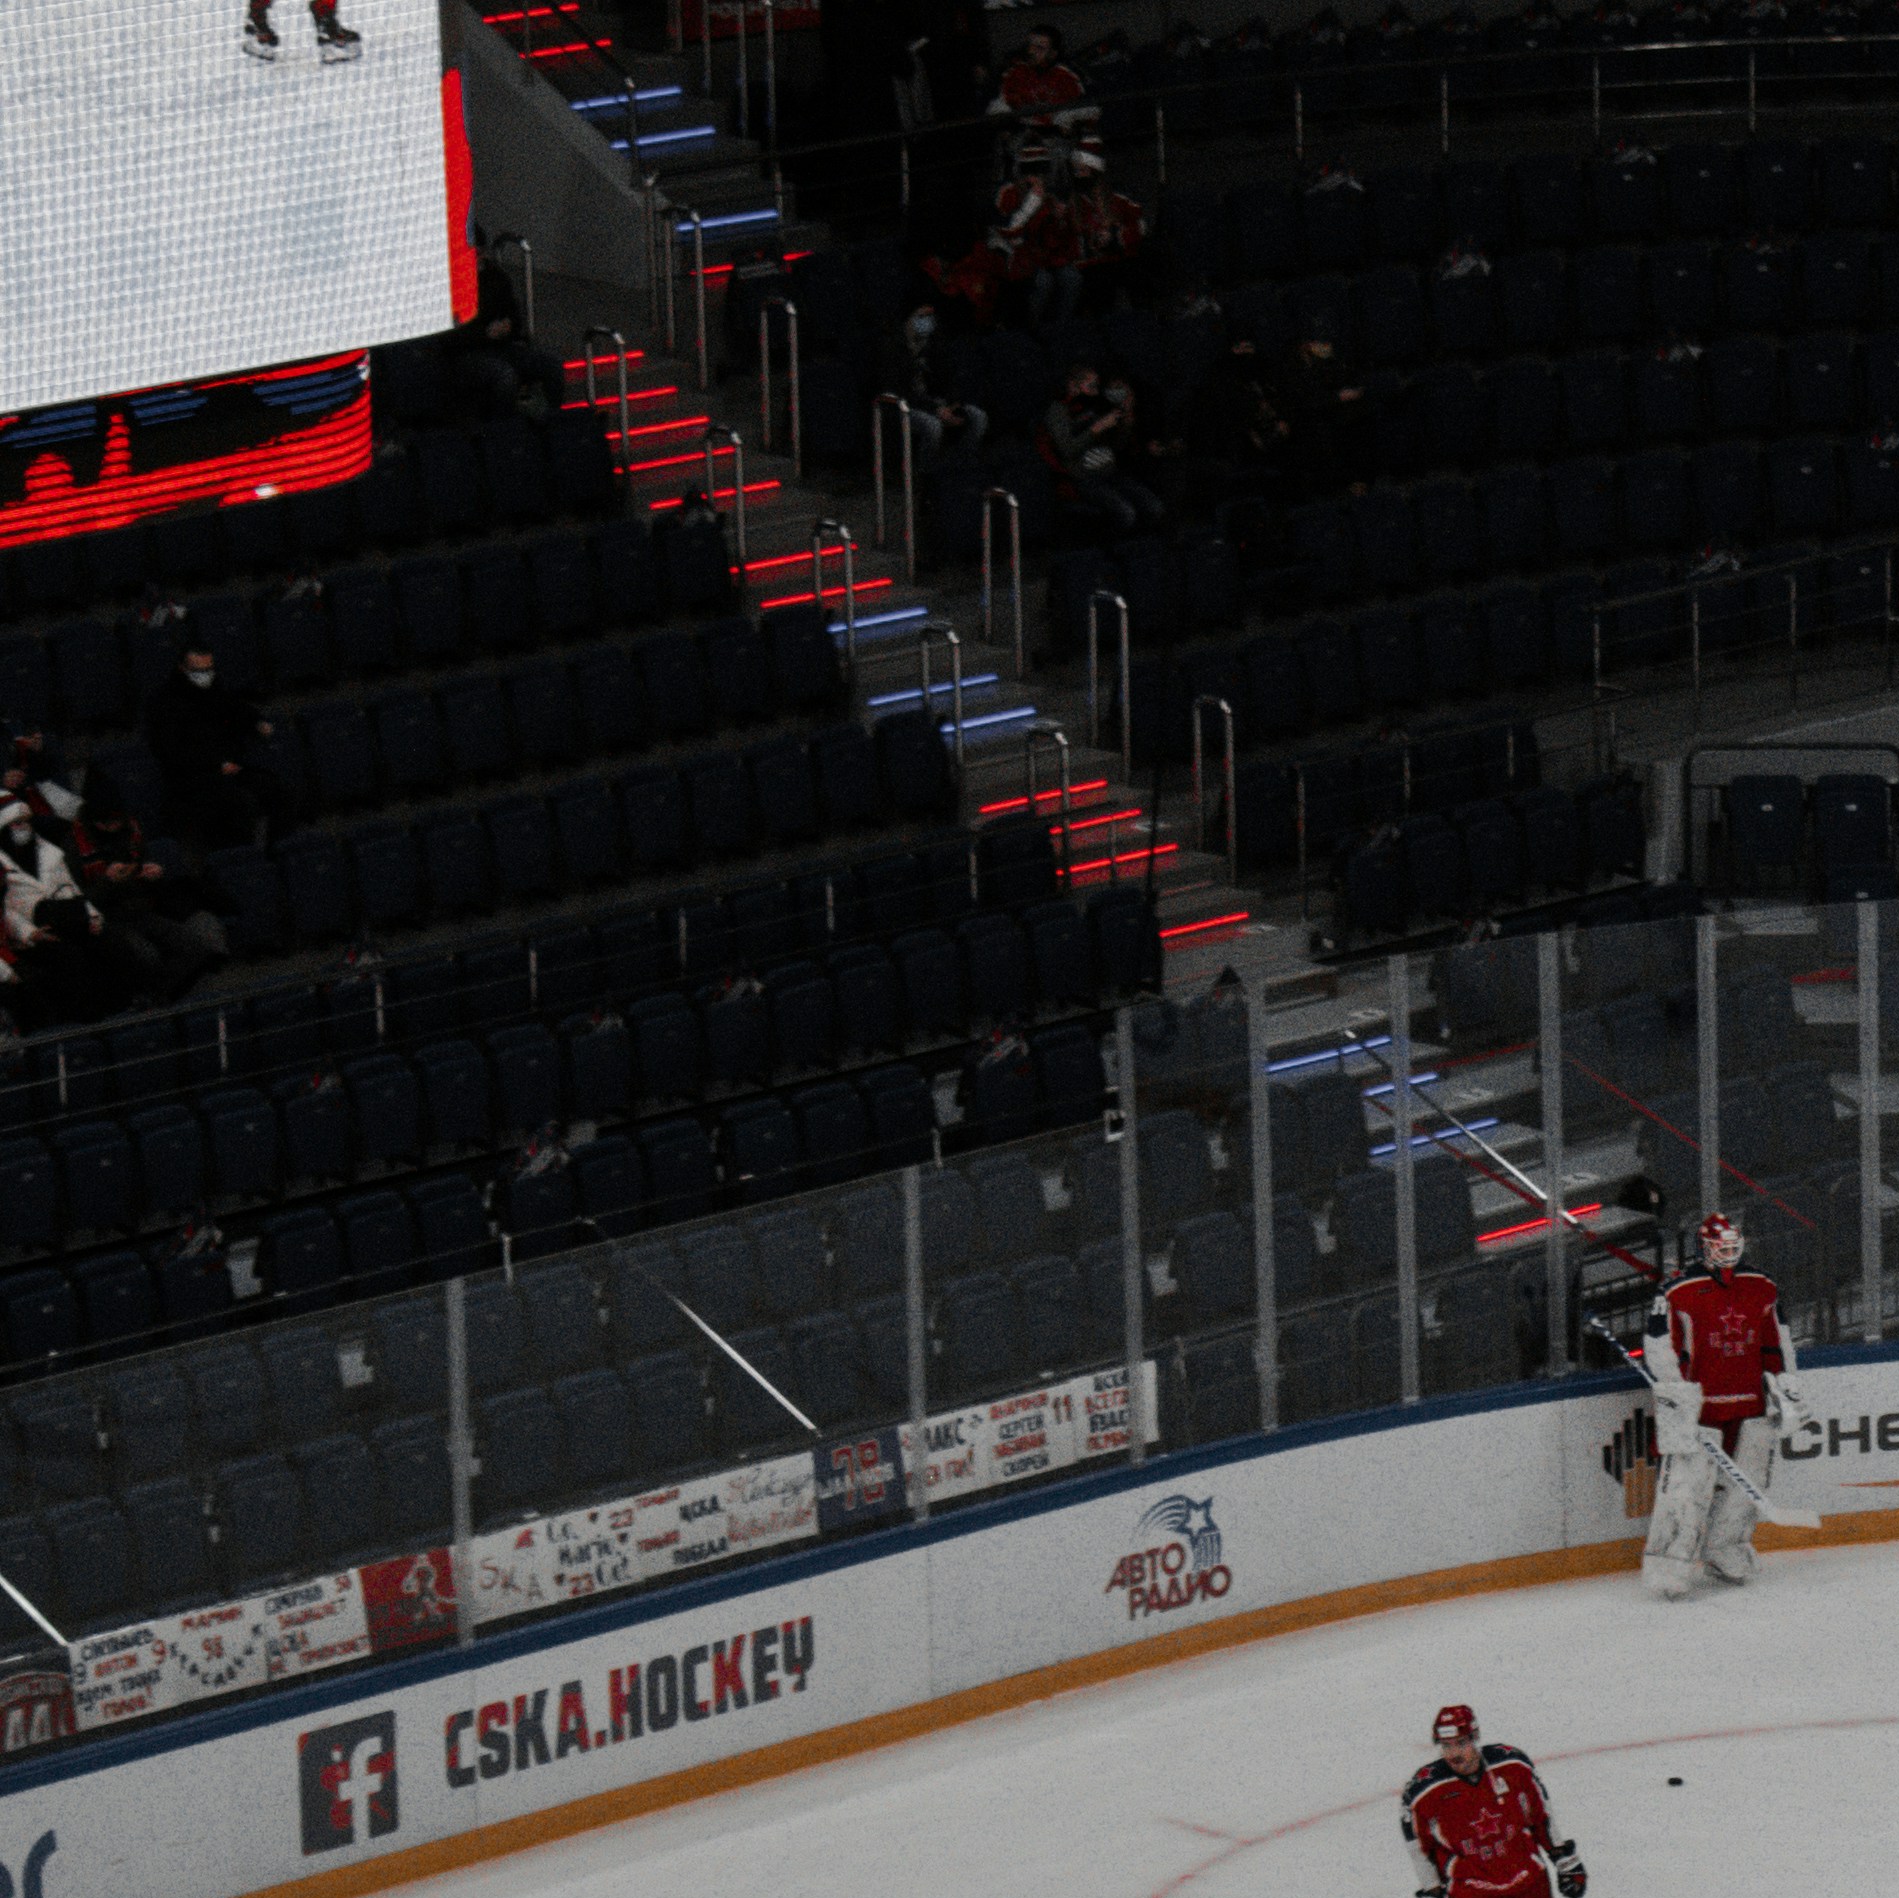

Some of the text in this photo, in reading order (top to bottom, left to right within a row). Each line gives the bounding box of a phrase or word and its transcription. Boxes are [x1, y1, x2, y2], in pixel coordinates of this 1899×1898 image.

[1103, 1541, 1187, 1595] АВТО
[1127, 1563, 1233, 1622] РАДИО
[444, 1615, 818, 1789] CSKA.HOCKEY
